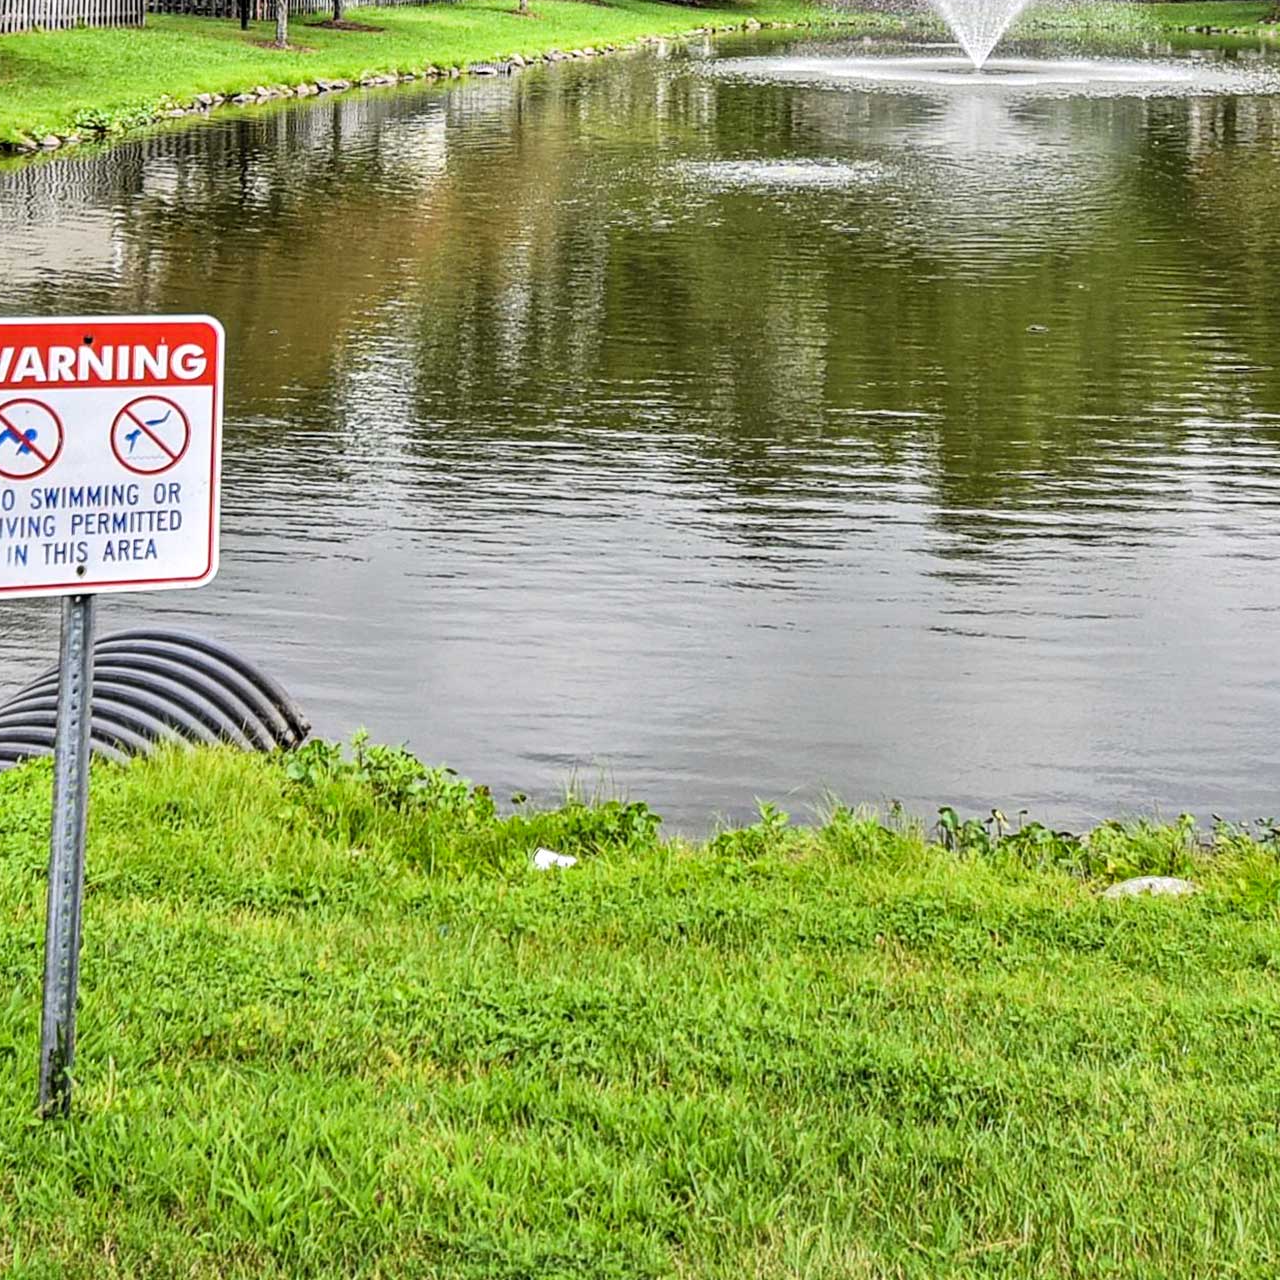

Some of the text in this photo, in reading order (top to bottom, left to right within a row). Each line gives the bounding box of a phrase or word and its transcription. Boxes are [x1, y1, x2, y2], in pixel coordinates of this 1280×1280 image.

[30, 484, 139, 510] SWIMMING
[153, 482, 181, 503] OR
[71, 510, 182, 535] PERMITTED
[7, 539, 157, 566] IN THIS AREA
